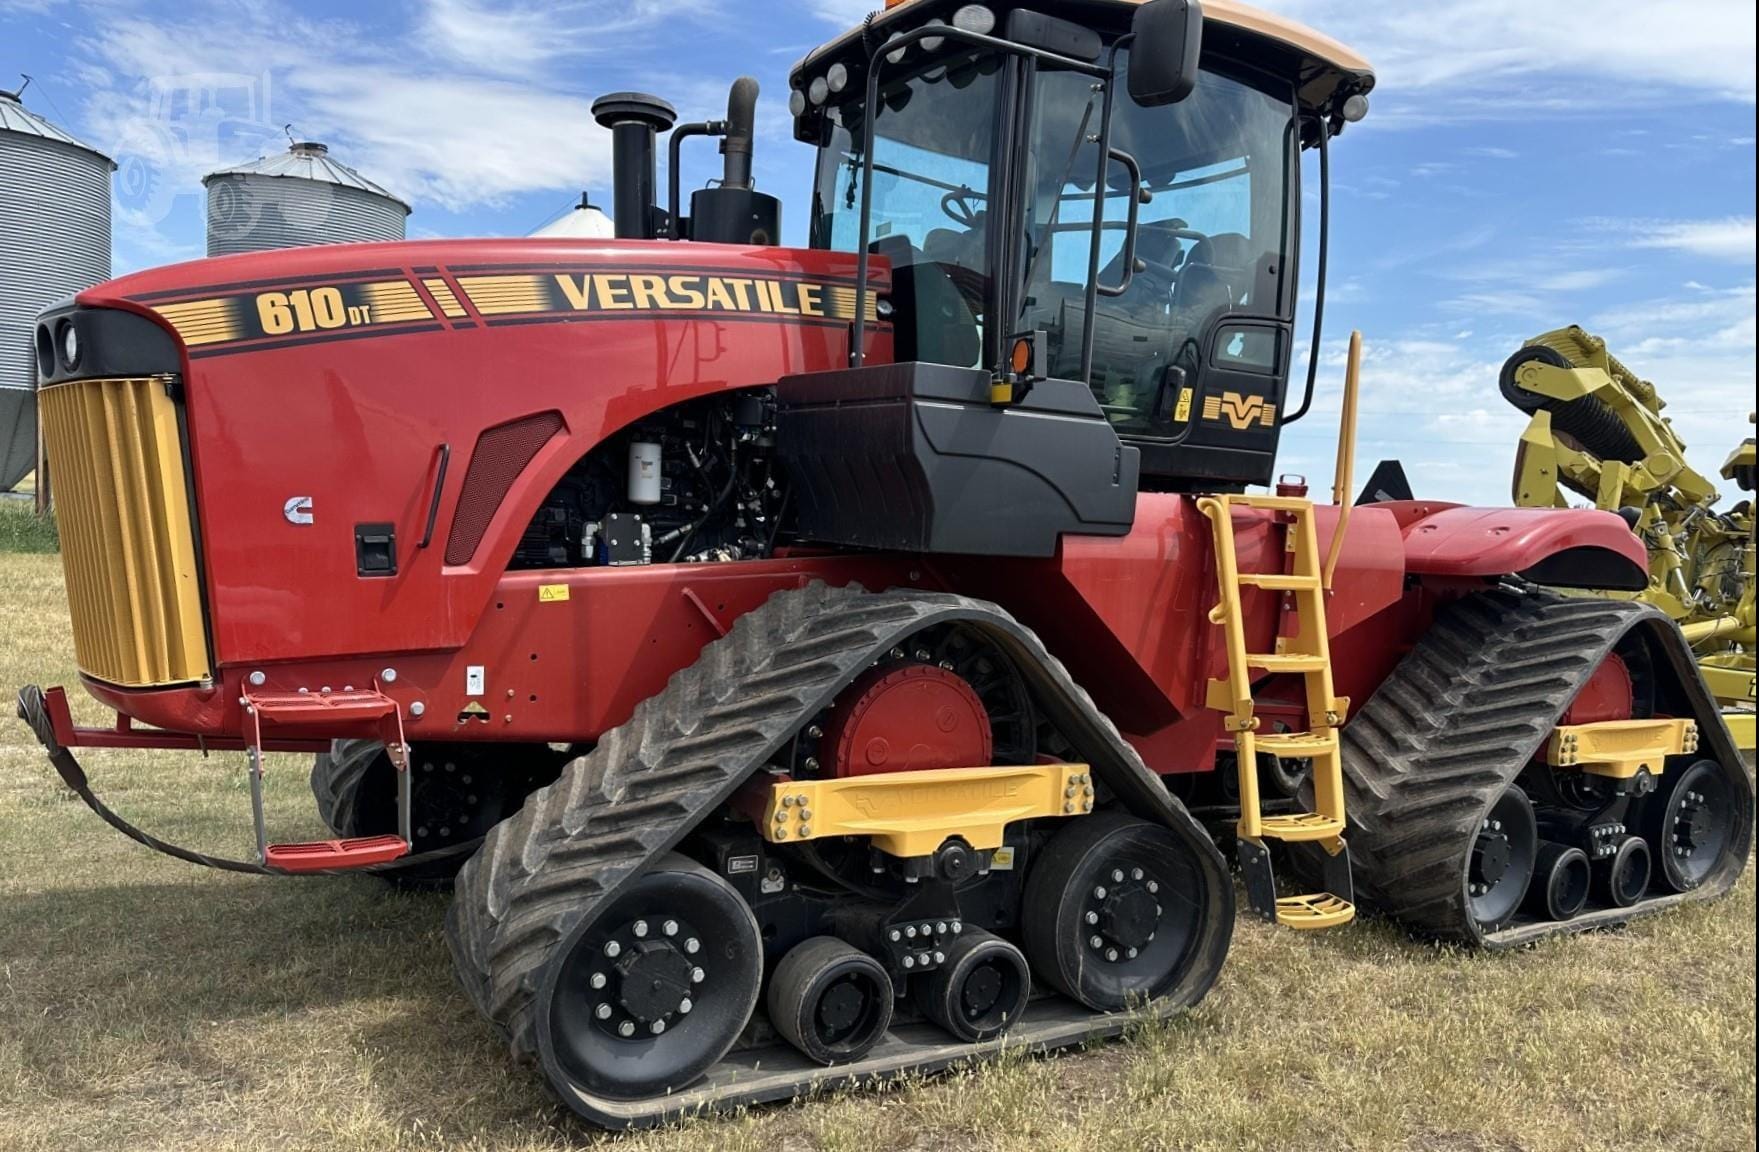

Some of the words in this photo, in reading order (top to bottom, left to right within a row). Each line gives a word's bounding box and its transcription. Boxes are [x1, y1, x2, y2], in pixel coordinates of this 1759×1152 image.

[256, 287, 347, 335] 610
[347, 305, 371, 326] DT
[554, 274, 825, 316] VERSATILE
